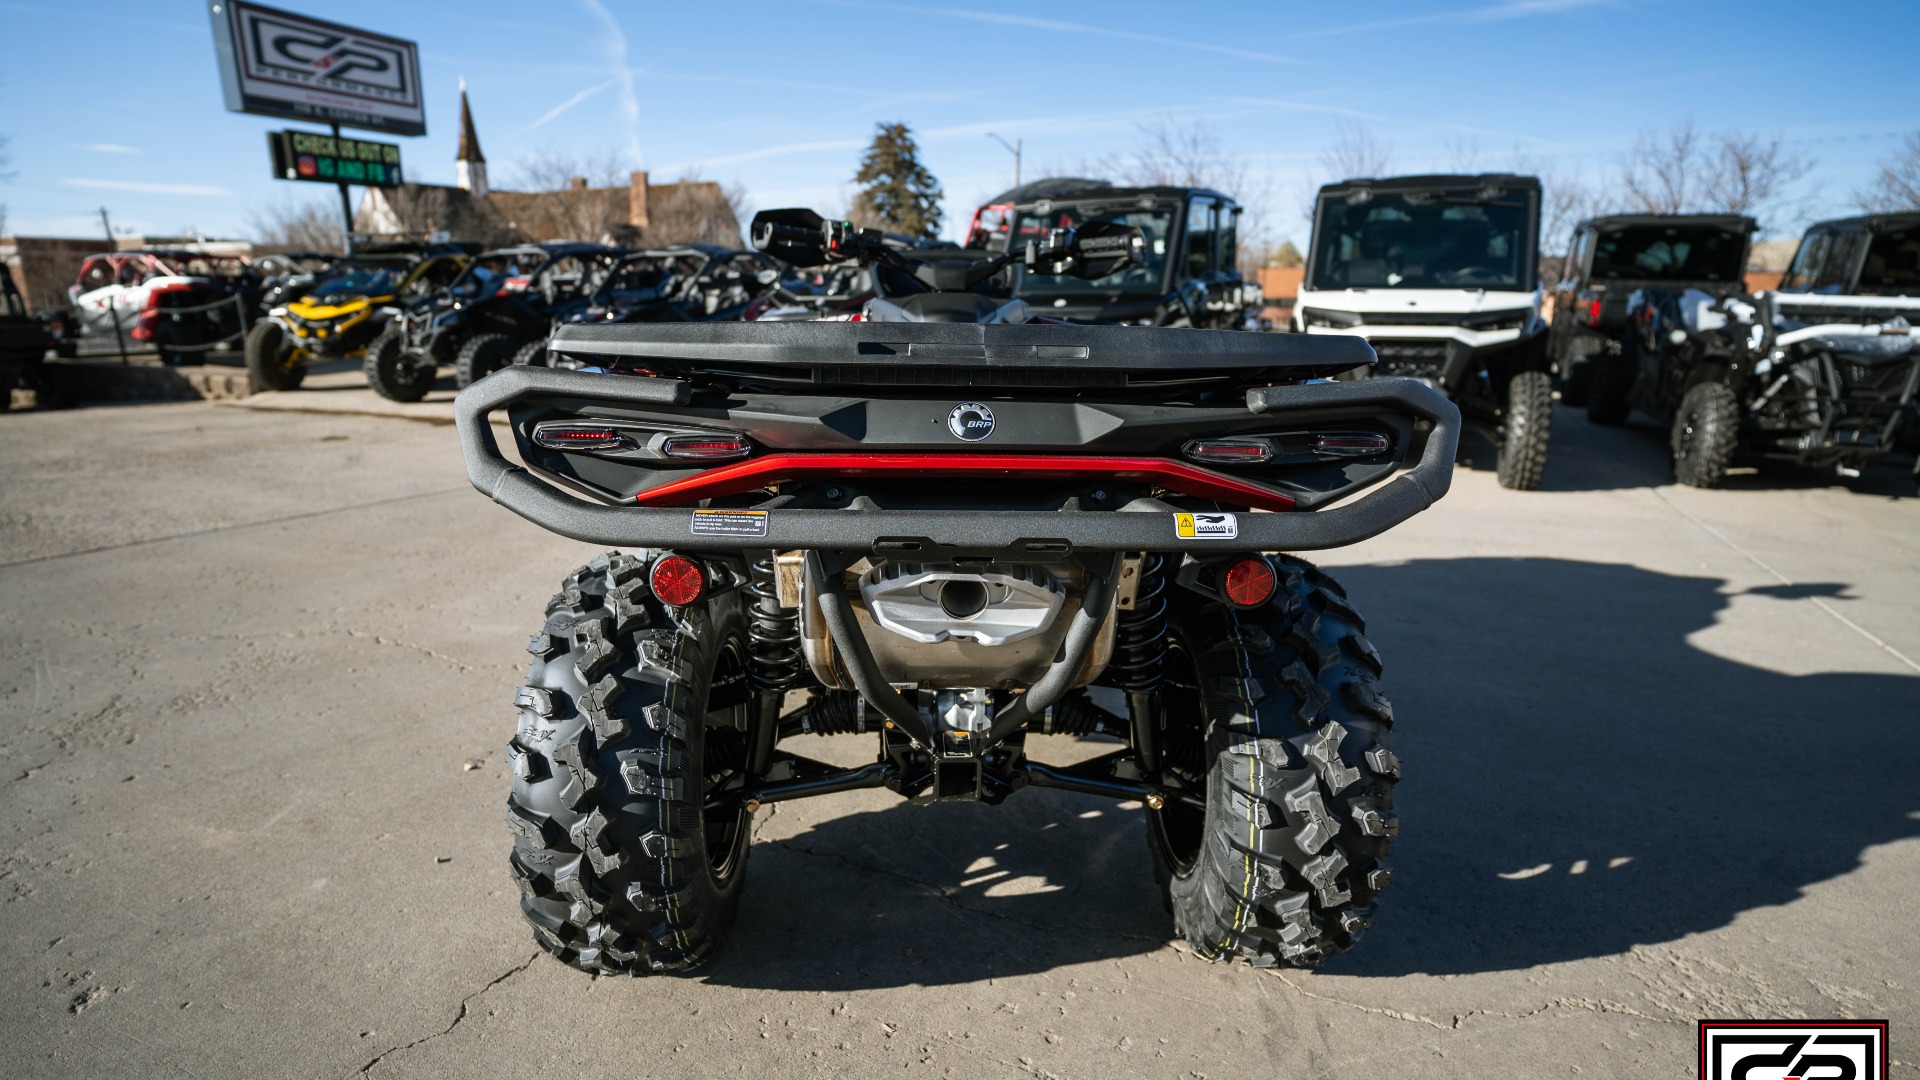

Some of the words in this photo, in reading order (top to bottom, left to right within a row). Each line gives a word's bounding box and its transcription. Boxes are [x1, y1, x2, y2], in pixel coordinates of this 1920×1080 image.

[255, 65, 408, 100] PERFORMANCE
[293, 133, 337, 157] CHECK
[338, 140, 356, 159] US
[357, 142, 381, 161] OUT
[337, 159, 366, 179] AND
[967, 420, 992, 428] BRP
